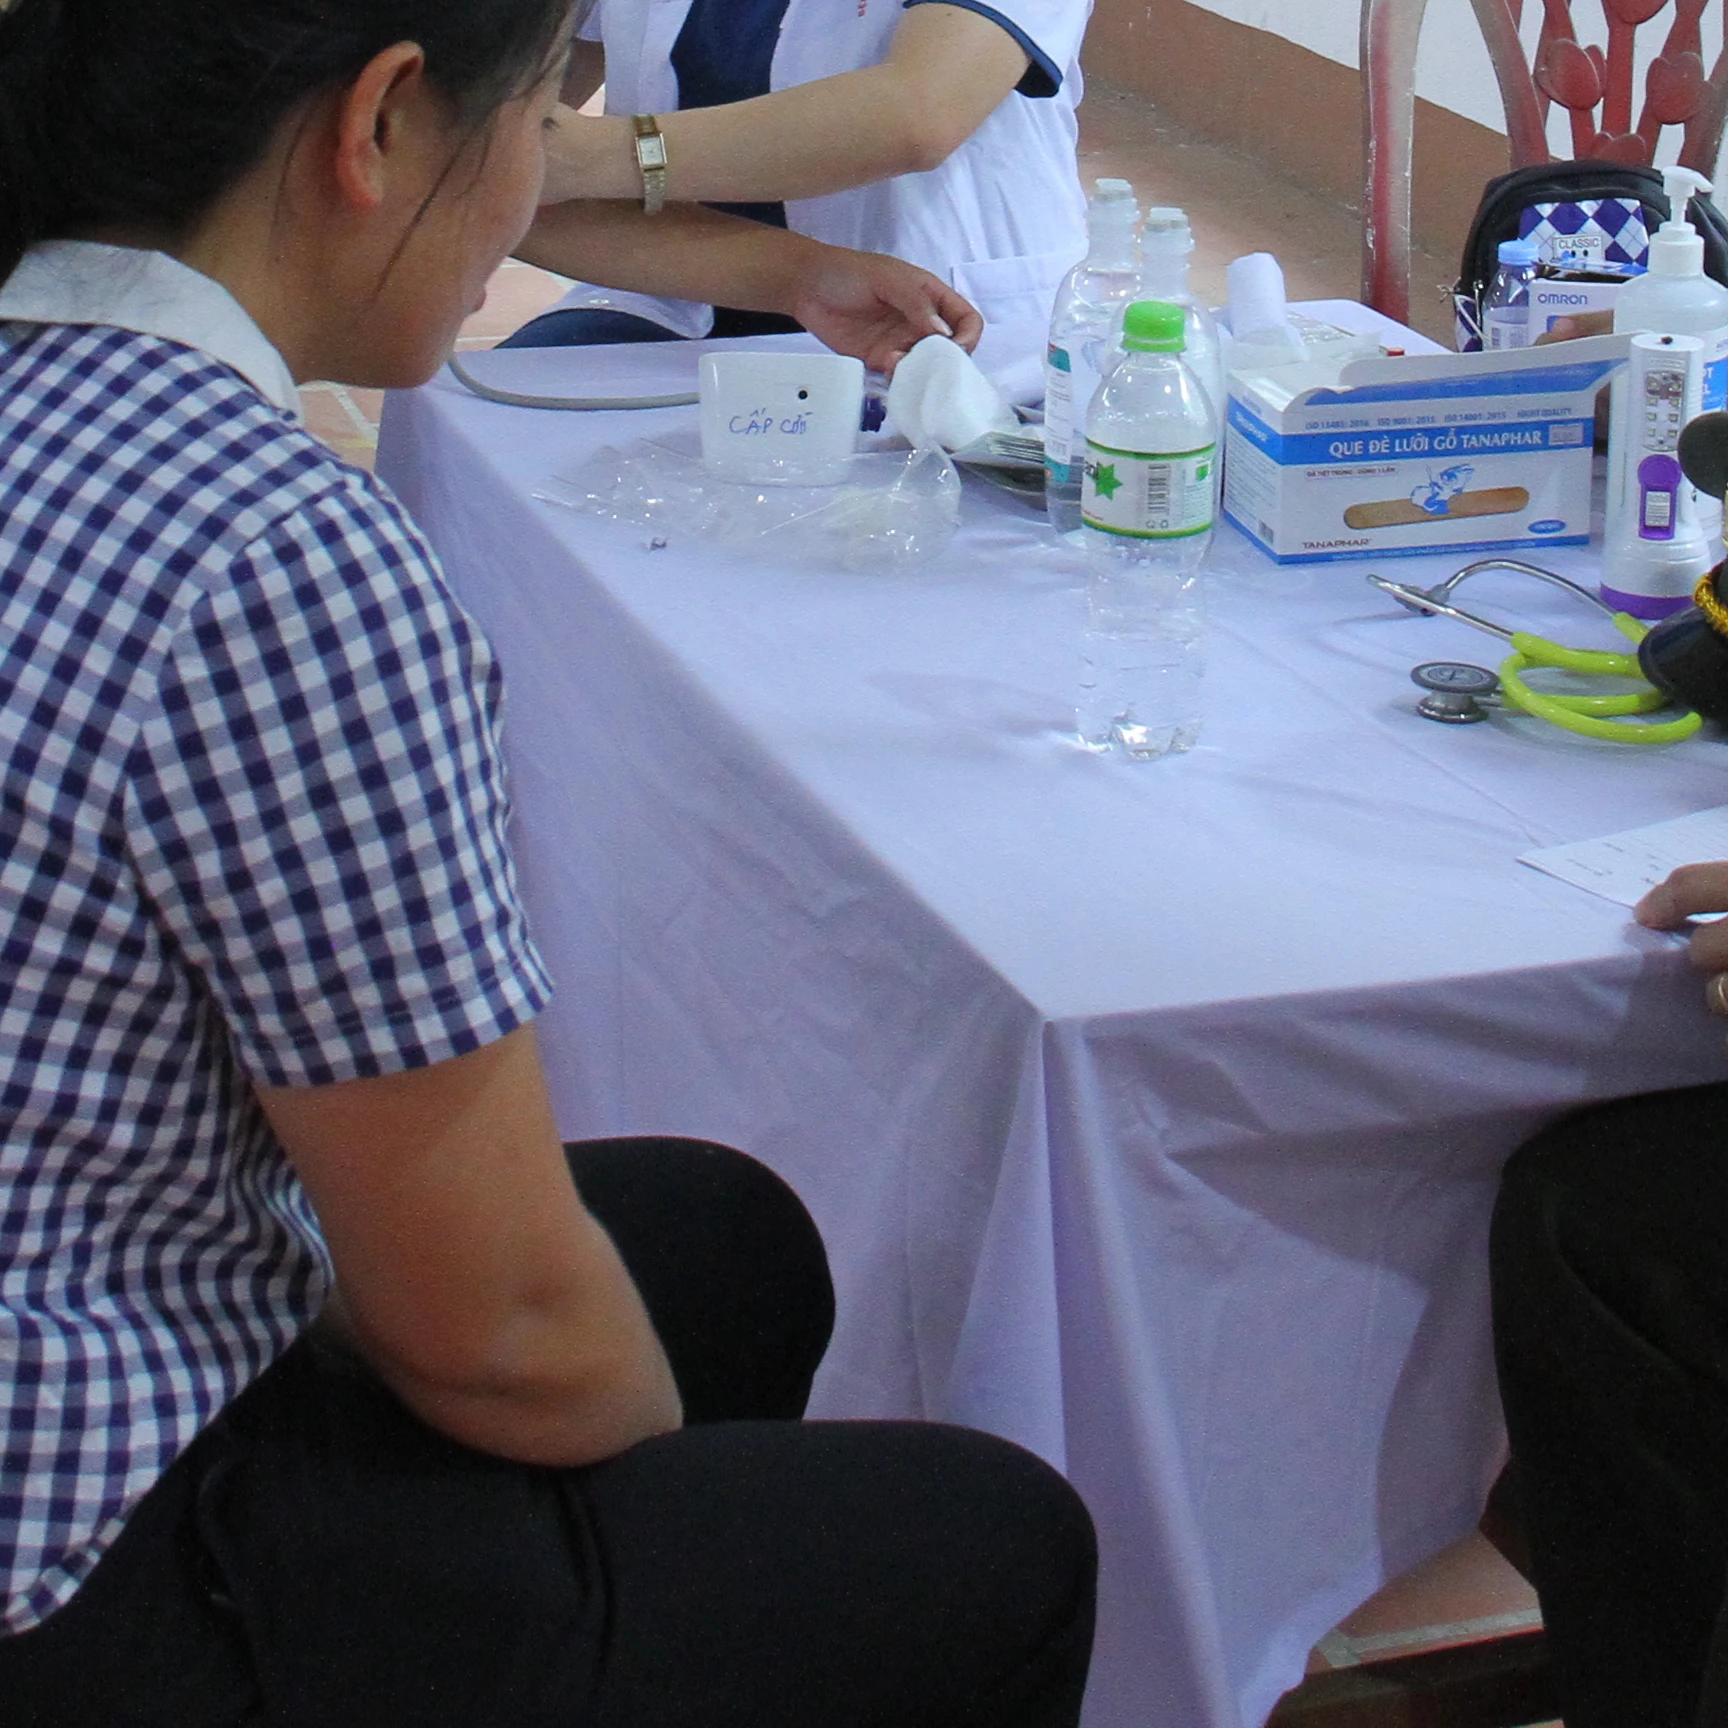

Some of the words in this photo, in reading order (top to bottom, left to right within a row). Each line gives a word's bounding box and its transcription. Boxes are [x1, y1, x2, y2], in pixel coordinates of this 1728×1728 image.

[1558, 237, 1600, 250] CLASSIC
[1537, 293, 1588, 305] OMRON
[1329, 440, 1364, 459] QUE
[1368, 435, 1390, 453] ĐÈ
[1433, 427, 1457, 450] GỖ
[1460, 430, 1542, 449] TANAPHAR
[1302, 538, 1369, 550] TANAPHAR
